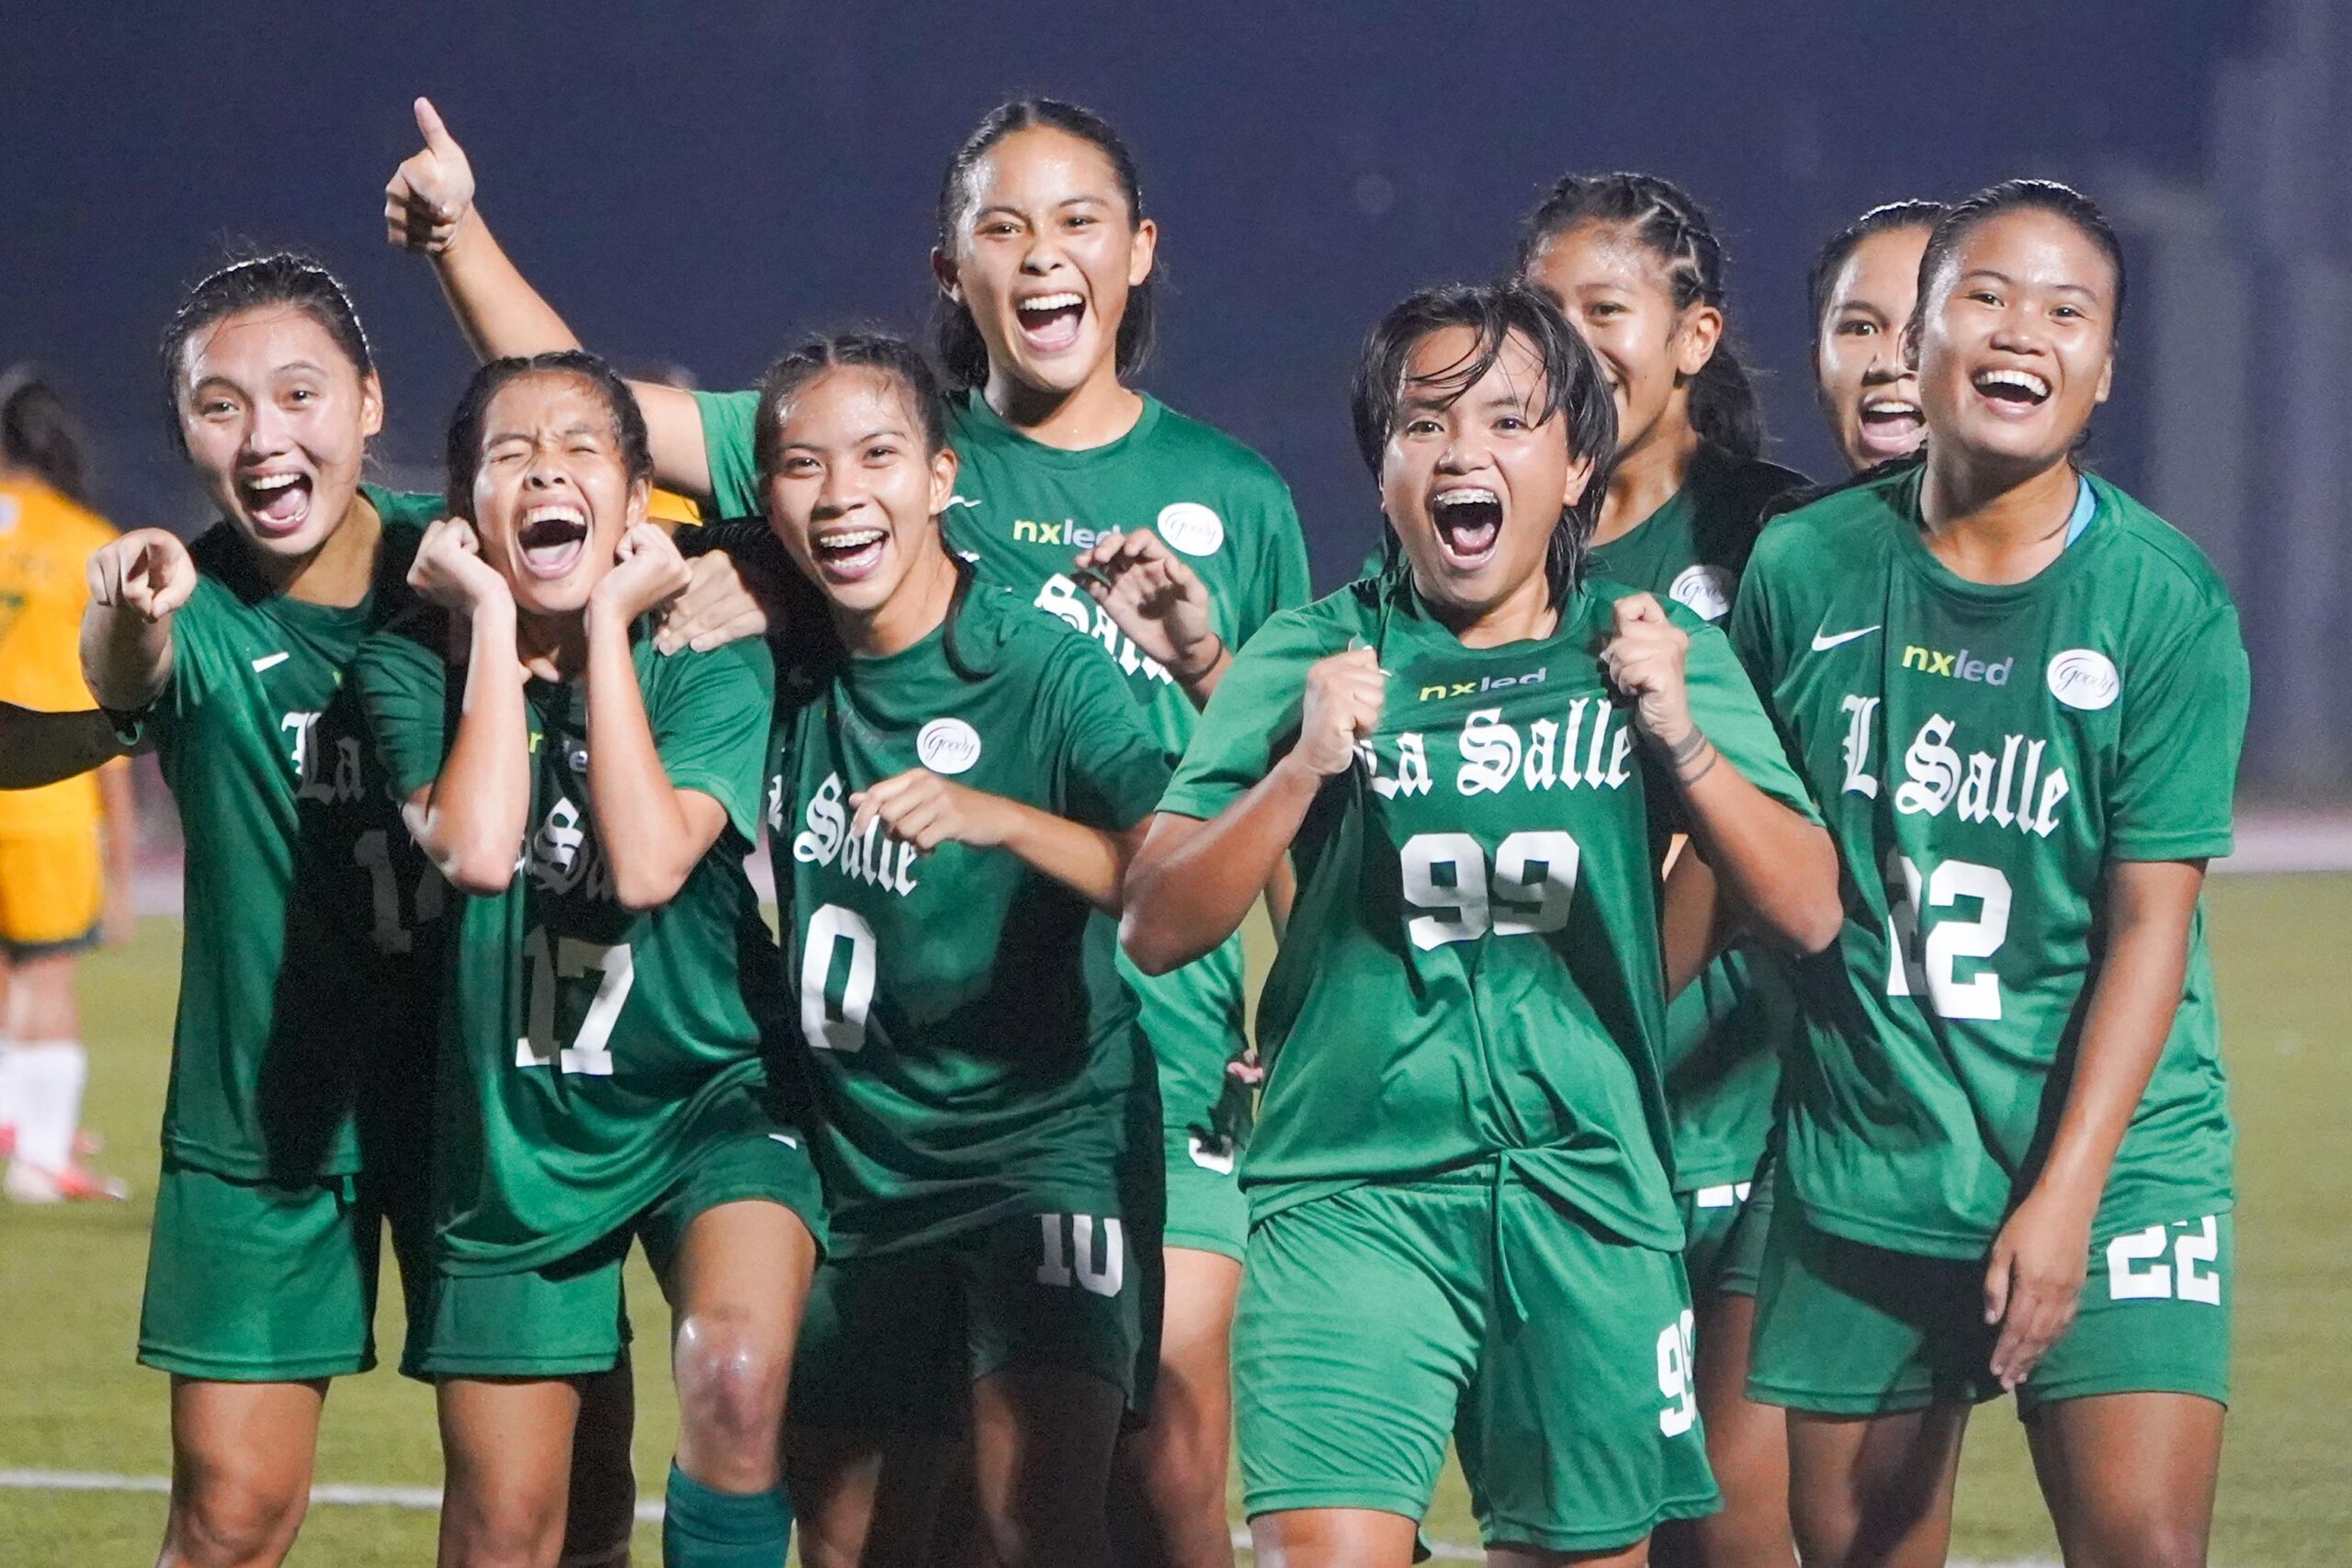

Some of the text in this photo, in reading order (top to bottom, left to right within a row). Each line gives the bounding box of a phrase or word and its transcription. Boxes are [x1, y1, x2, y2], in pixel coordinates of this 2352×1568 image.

[1419, 667, 1547, 702] nxled
[1901, 644, 2014, 687] nxled
[280, 711, 366, 807] La
[1456, 696, 1635, 796] Salle
[1894, 712, 2070, 839] Salle
[1399, 829, 1580, 952] 99
[515, 923, 635, 1076] 17
[2106, 1213, 2221, 1306] 22
